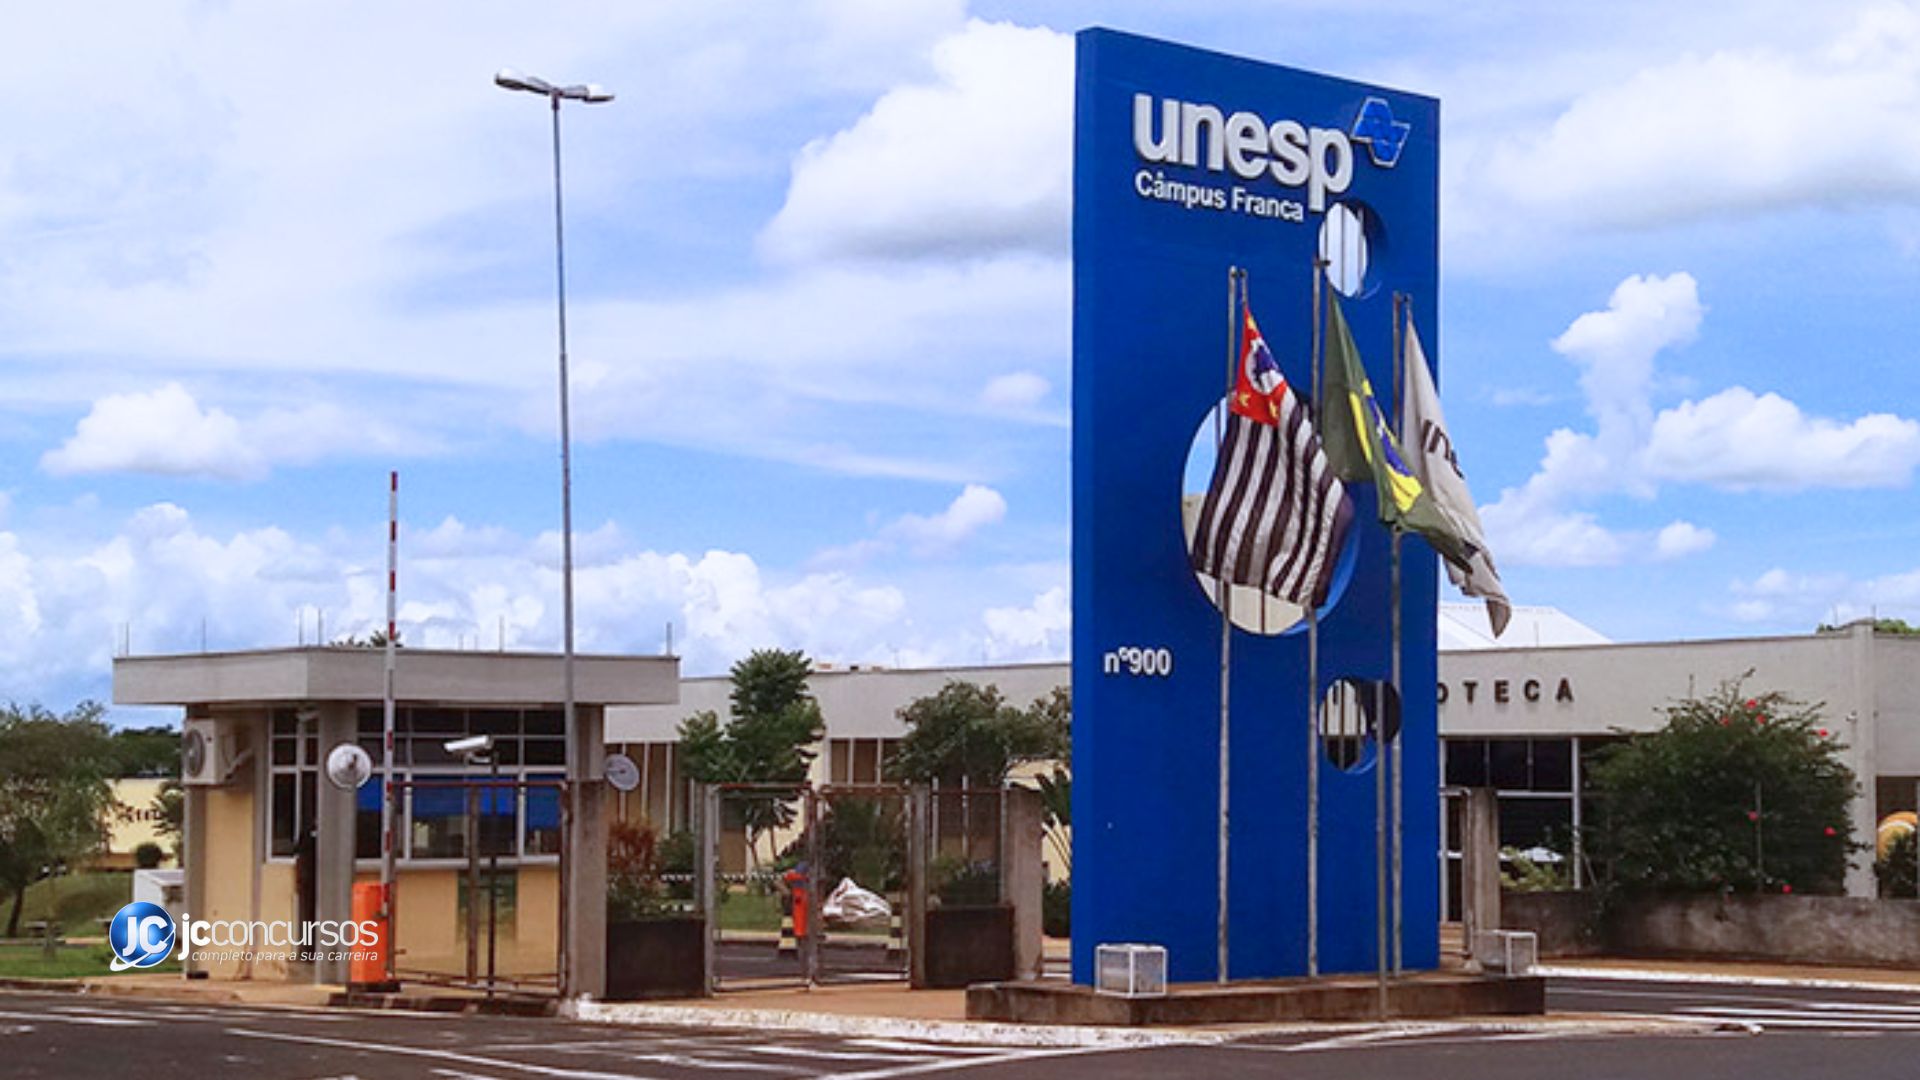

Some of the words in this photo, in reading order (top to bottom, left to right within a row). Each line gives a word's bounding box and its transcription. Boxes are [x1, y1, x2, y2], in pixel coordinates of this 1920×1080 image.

[1134, 92, 1353, 213] unesp
[1134, 169, 1227, 210] Câmpus
[1231, 186, 1304, 223] Franca
[1437, 677, 1574, 704] OTECA
